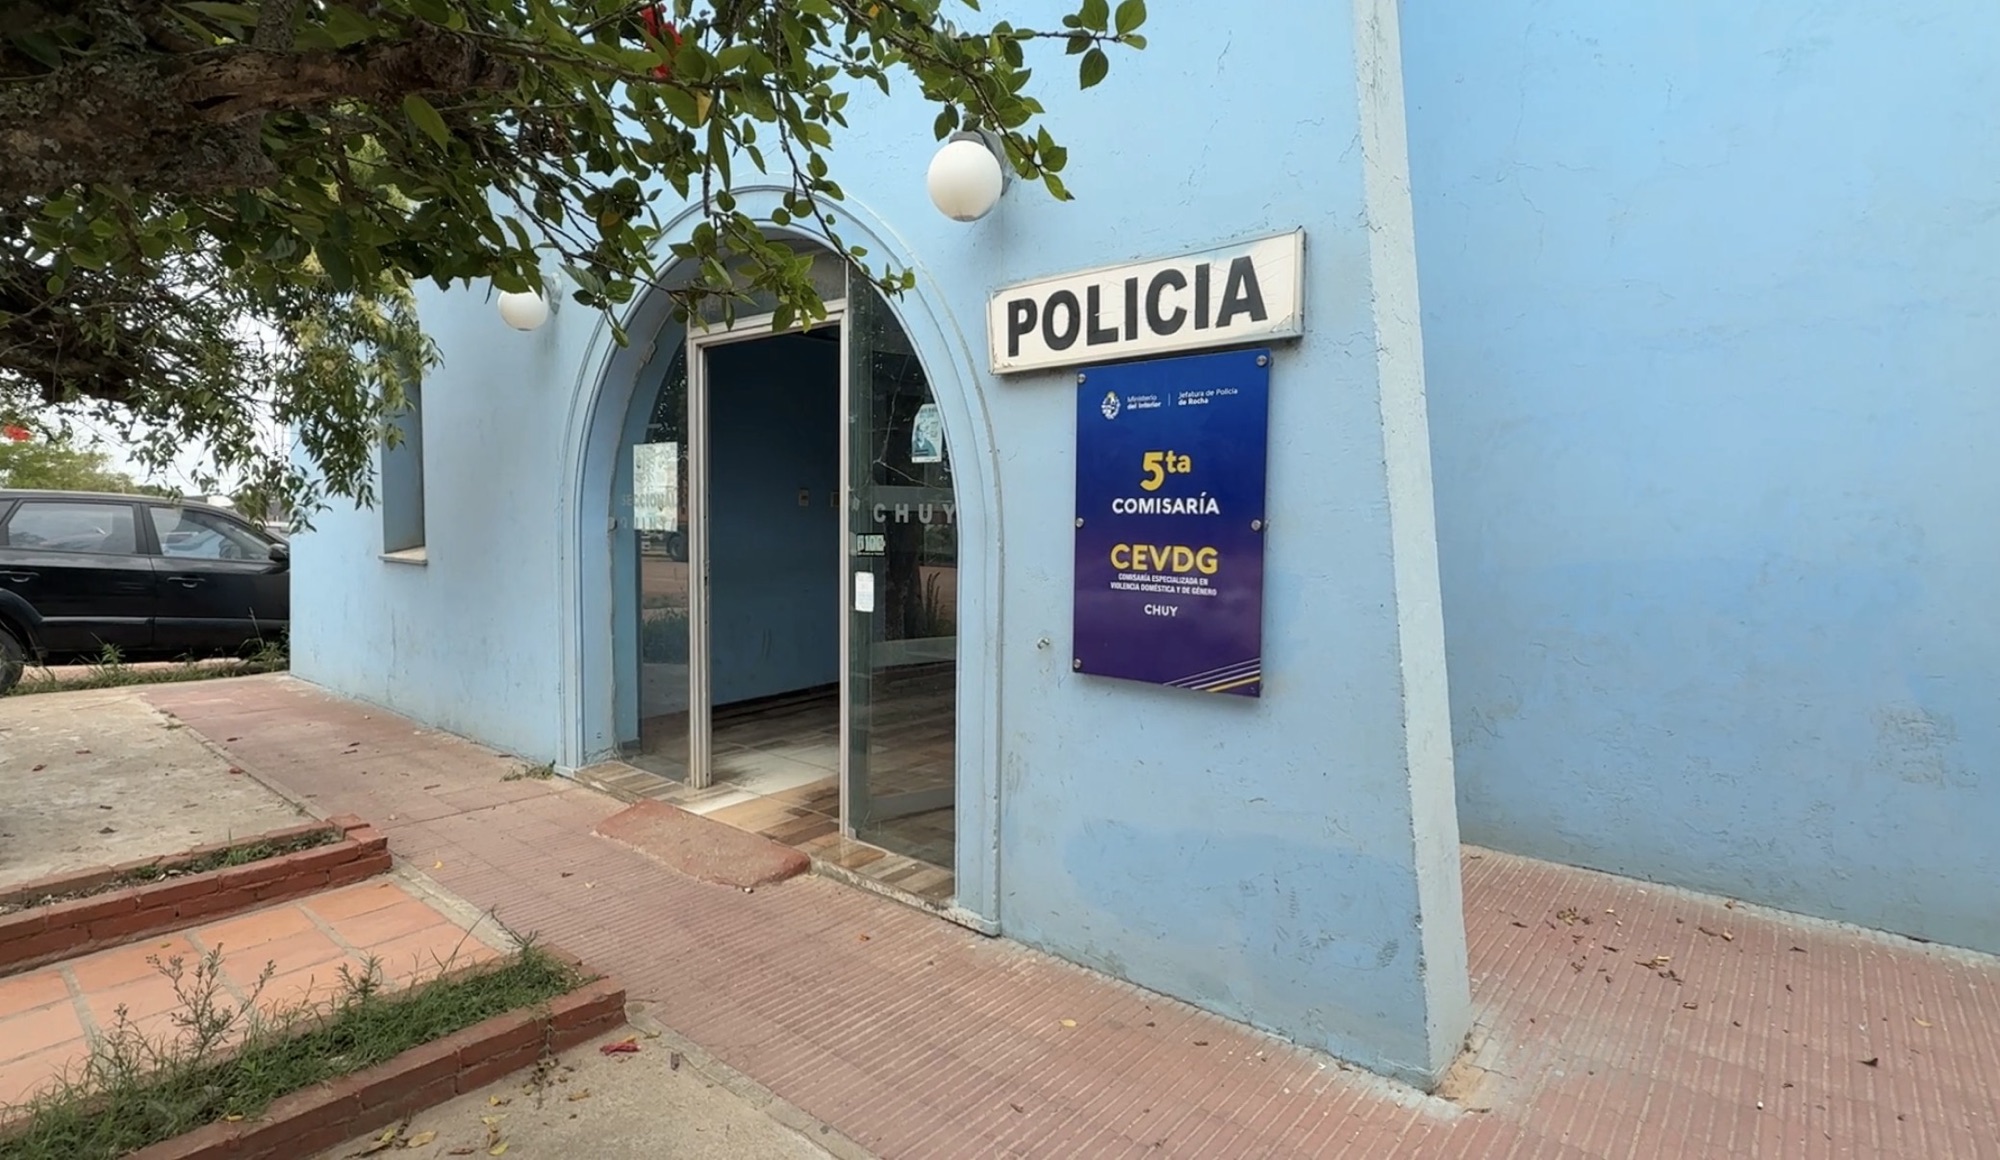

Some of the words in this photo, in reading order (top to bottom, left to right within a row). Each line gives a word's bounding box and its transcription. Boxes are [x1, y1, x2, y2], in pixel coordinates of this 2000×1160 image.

[1008, 255, 1268, 357] POLICIA
[1178, 391, 1204, 399] Jefatura
[1178, 398, 1187, 406] de
[1188, 397, 1209, 405] Rocha
[1140, 450, 1191, 491] 5ta
[1112, 491, 1220, 514] COMISARÍA
[873, 503, 955, 524] CHUY
[1110, 543, 1218, 574] CEVDG
[1118, 572, 1151, 582] COMISARÍA
[1152, 574, 1198, 585] ESPECIALIZADA
[1199, 577, 1208, 586] EN
[1110, 581, 1140, 591] VIOLENCIA
[1141, 582, 1175, 593] DOMÉSTICA
[1176, 586, 1181, 594] Y
[1182, 586, 1190, 594] DE
[1191, 586, 1218, 597] GÉNERO
[1144, 604, 1178, 617] CHUY
